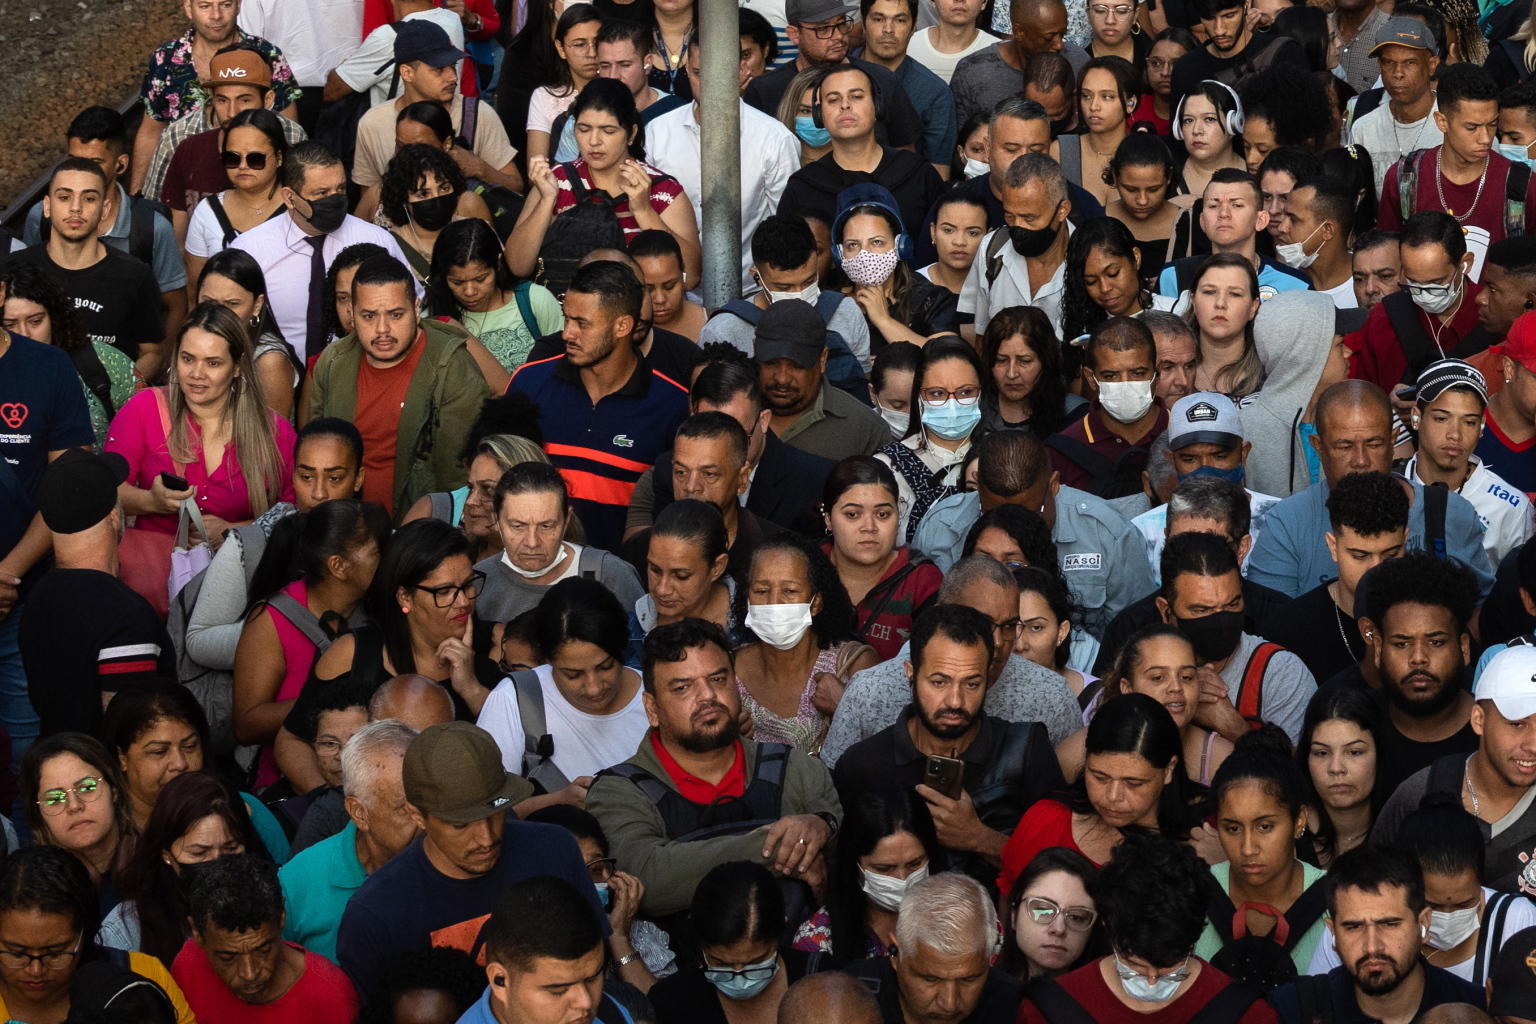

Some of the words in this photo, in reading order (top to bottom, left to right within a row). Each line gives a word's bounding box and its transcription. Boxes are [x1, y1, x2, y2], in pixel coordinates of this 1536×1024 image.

[219, 67, 248, 79] NYC
[74, 297, 104, 313] your
[1487, 483, 1521, 508] Itaú
